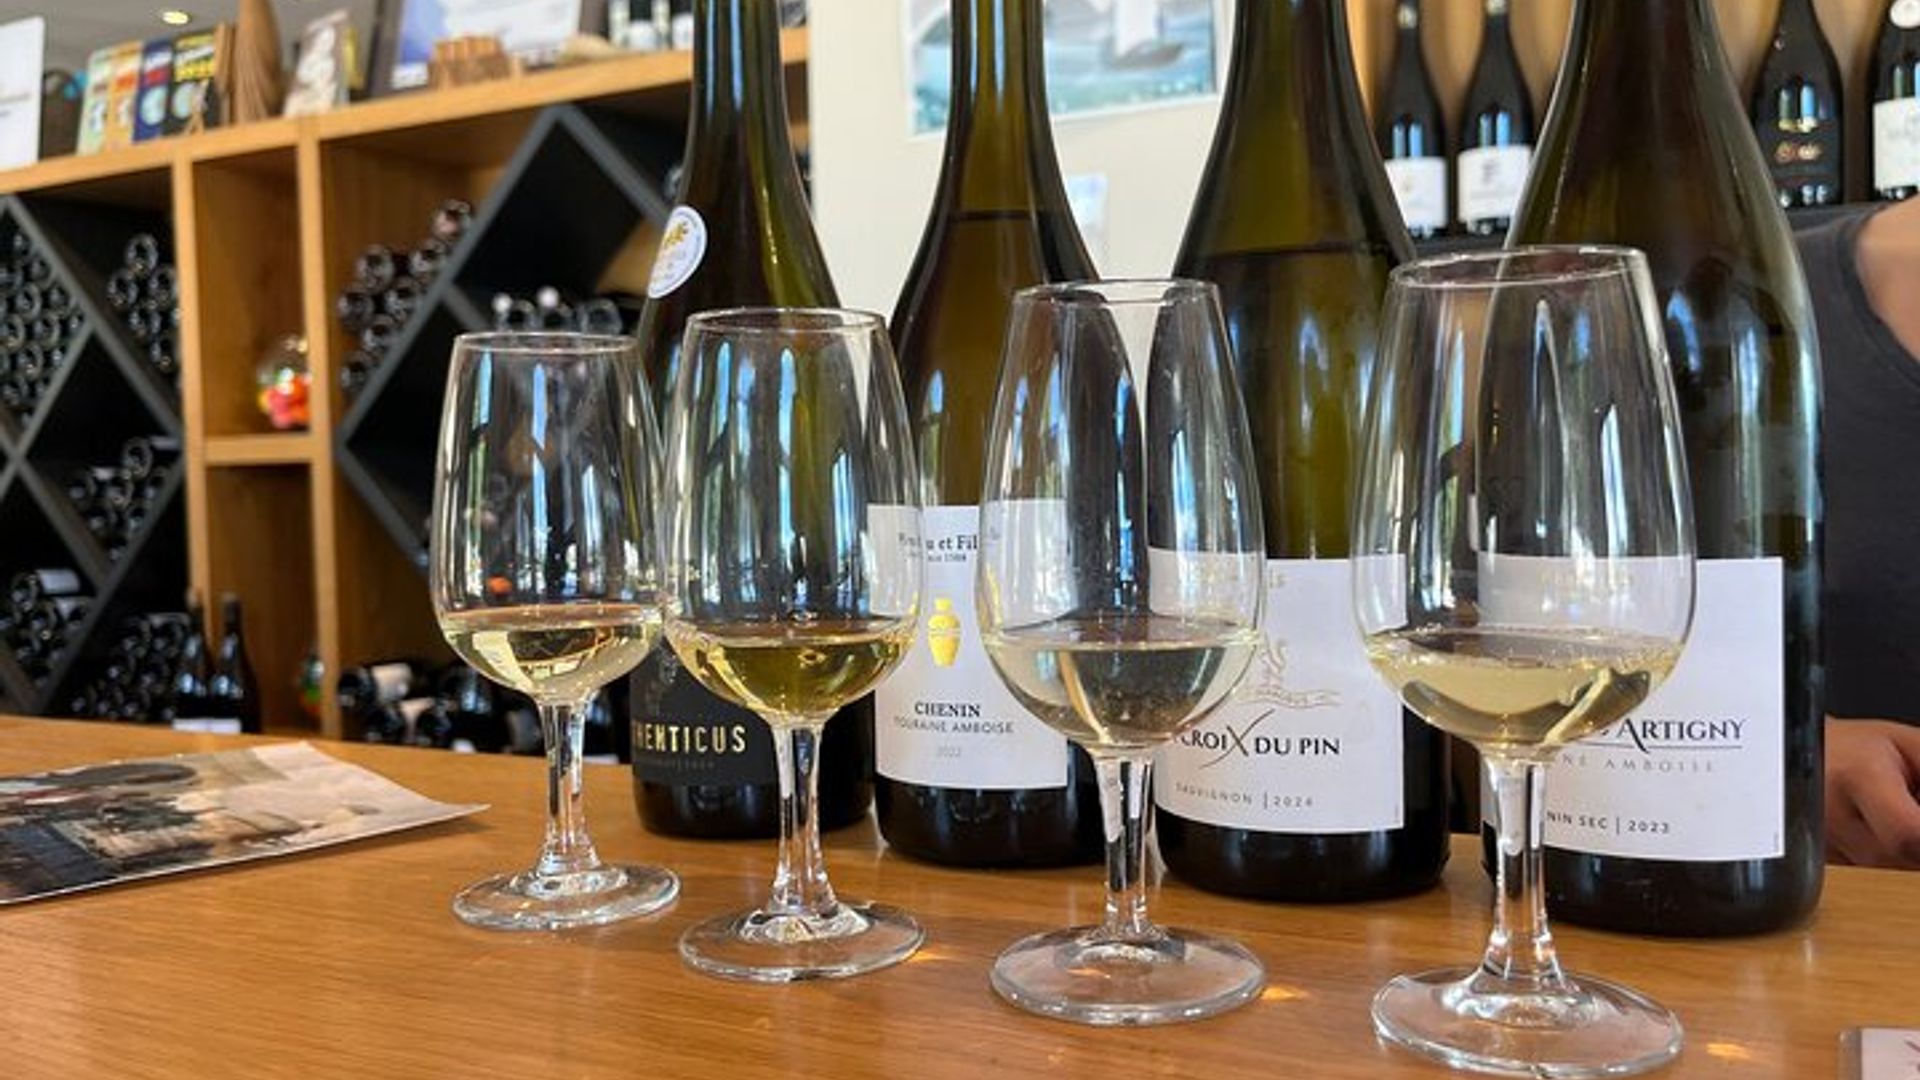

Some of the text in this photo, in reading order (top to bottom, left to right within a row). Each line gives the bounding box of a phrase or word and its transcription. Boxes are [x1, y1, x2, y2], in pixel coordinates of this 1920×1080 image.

[956, 534, 978, 550] Fil
[914, 701, 981, 718] CHENIN
[952, 722, 1015, 734] AMBOISE
[1255, 736, 1291, 756] DU
[1299, 737, 1340, 756] PIN
[1175, 781, 1252, 806] SAUVIGNON
[1546, 811, 1572, 825] NIN
[1578, 816, 1609, 830] SEC
